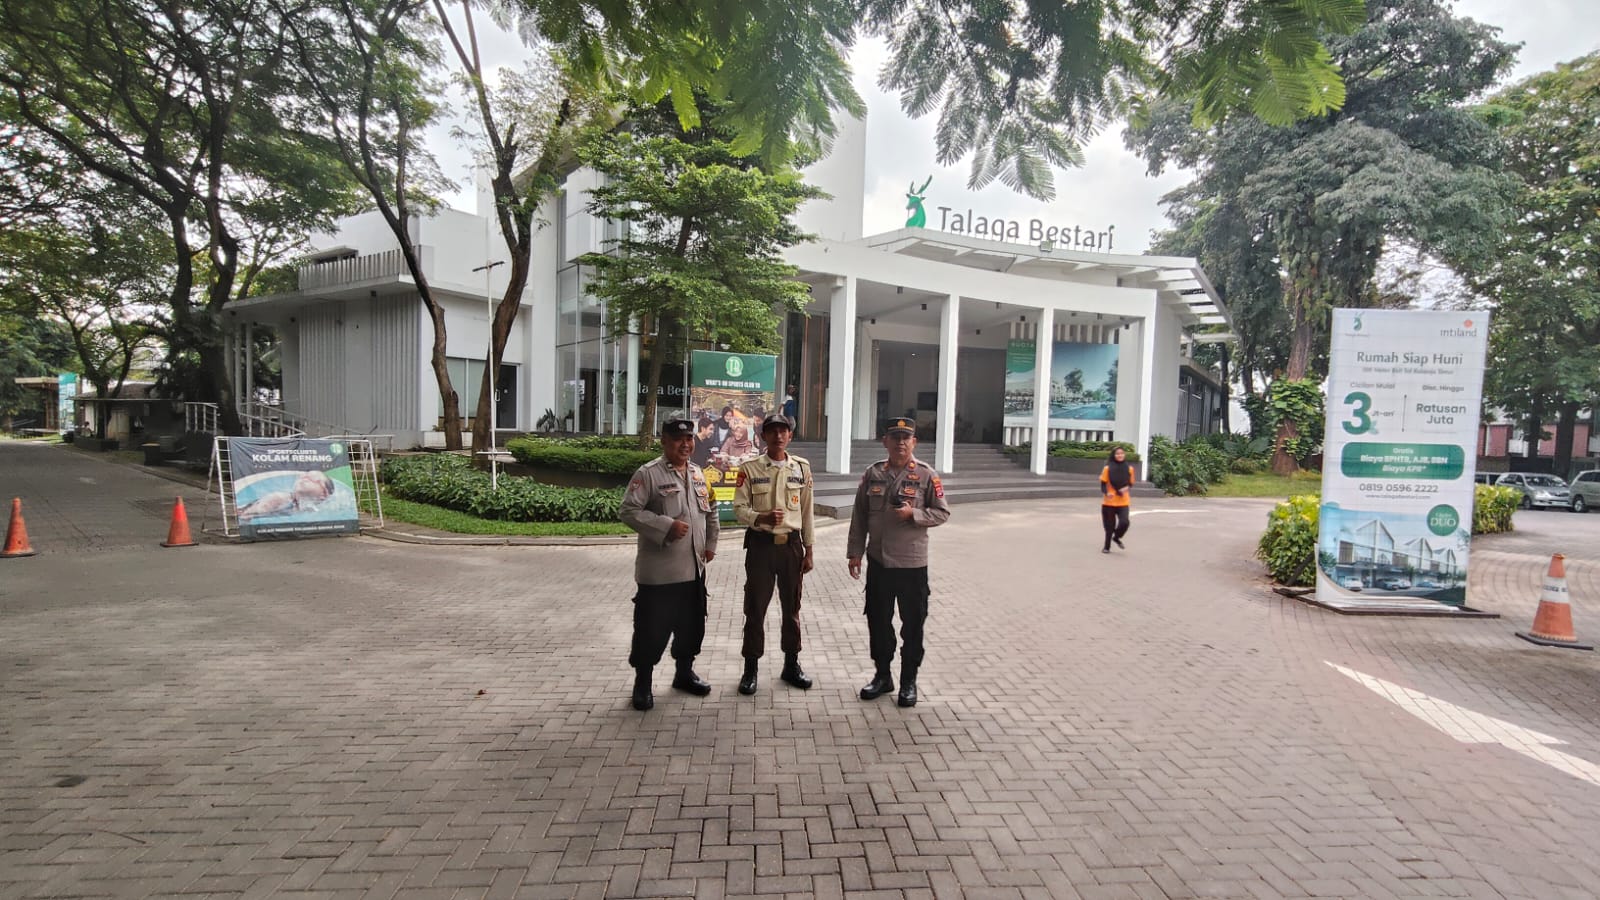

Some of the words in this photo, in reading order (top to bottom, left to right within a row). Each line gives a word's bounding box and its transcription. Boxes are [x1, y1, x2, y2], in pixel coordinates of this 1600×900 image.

[937, 206, 1020, 242] Talaga
[1029, 218, 1115, 250] Bestari
[1440, 328, 1477, 337] intiland
[1357, 351, 1398, 363] Rumah
[1403, 352, 1428, 367] Siap
[1433, 353, 1463, 365] Huni
[1342, 391, 1372, 435] 3
[1416, 403, 1467, 414] Ratusan
[1426, 415, 1454, 425] Juta
[252, 454, 290, 462] KOLAM
[292, 454, 333, 462] RENANG
[1359, 483, 1383, 491] 0819
[1385, 484, 1412, 492] 0596
